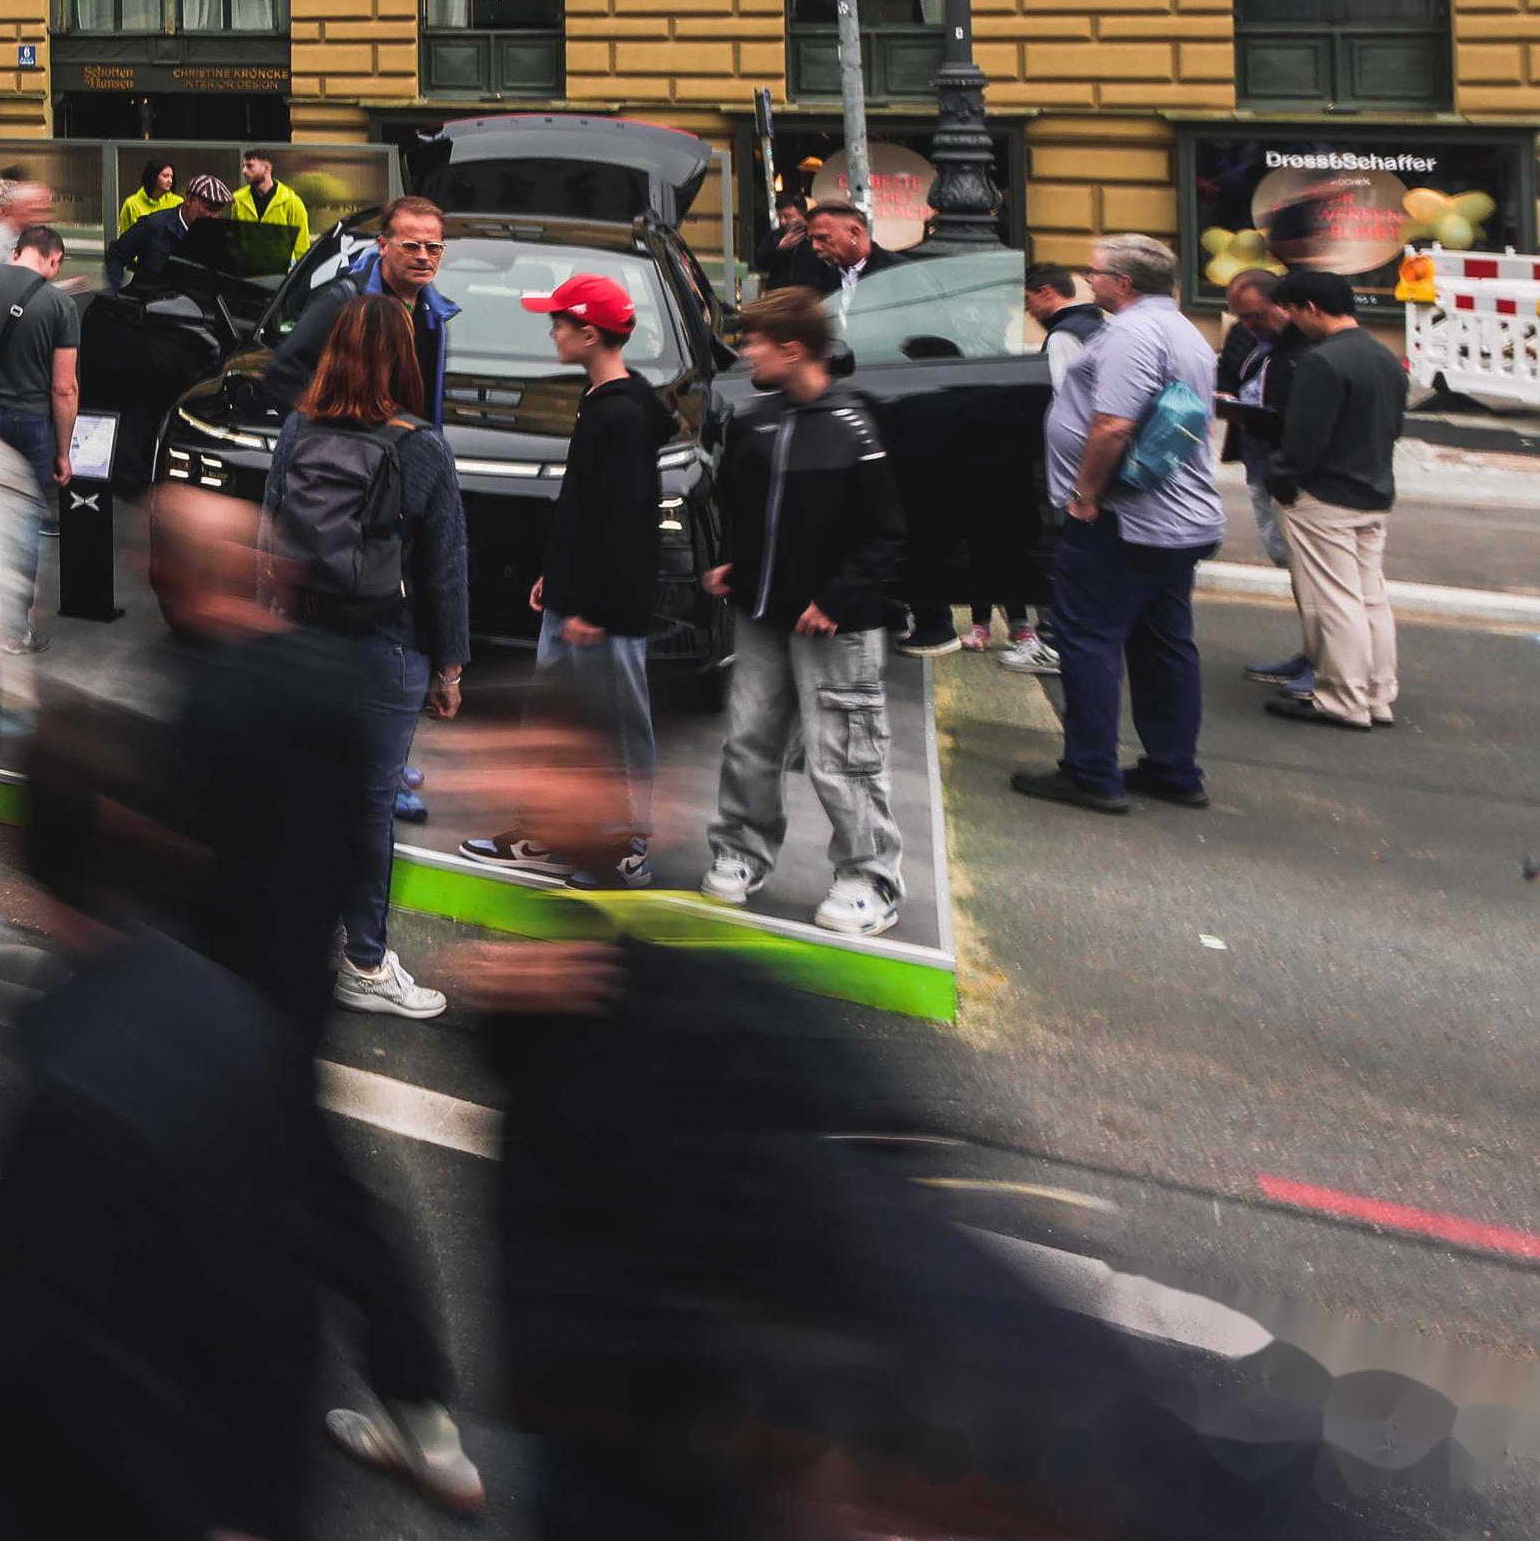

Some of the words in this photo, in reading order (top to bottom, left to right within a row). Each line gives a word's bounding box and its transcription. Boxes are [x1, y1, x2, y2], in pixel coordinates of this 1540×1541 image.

[173, 68, 231, 80] CHRISTINE
[233, 67, 289, 80] KRÖNCKE
[1265, 150, 1438, 173] Dross&Schaffer
